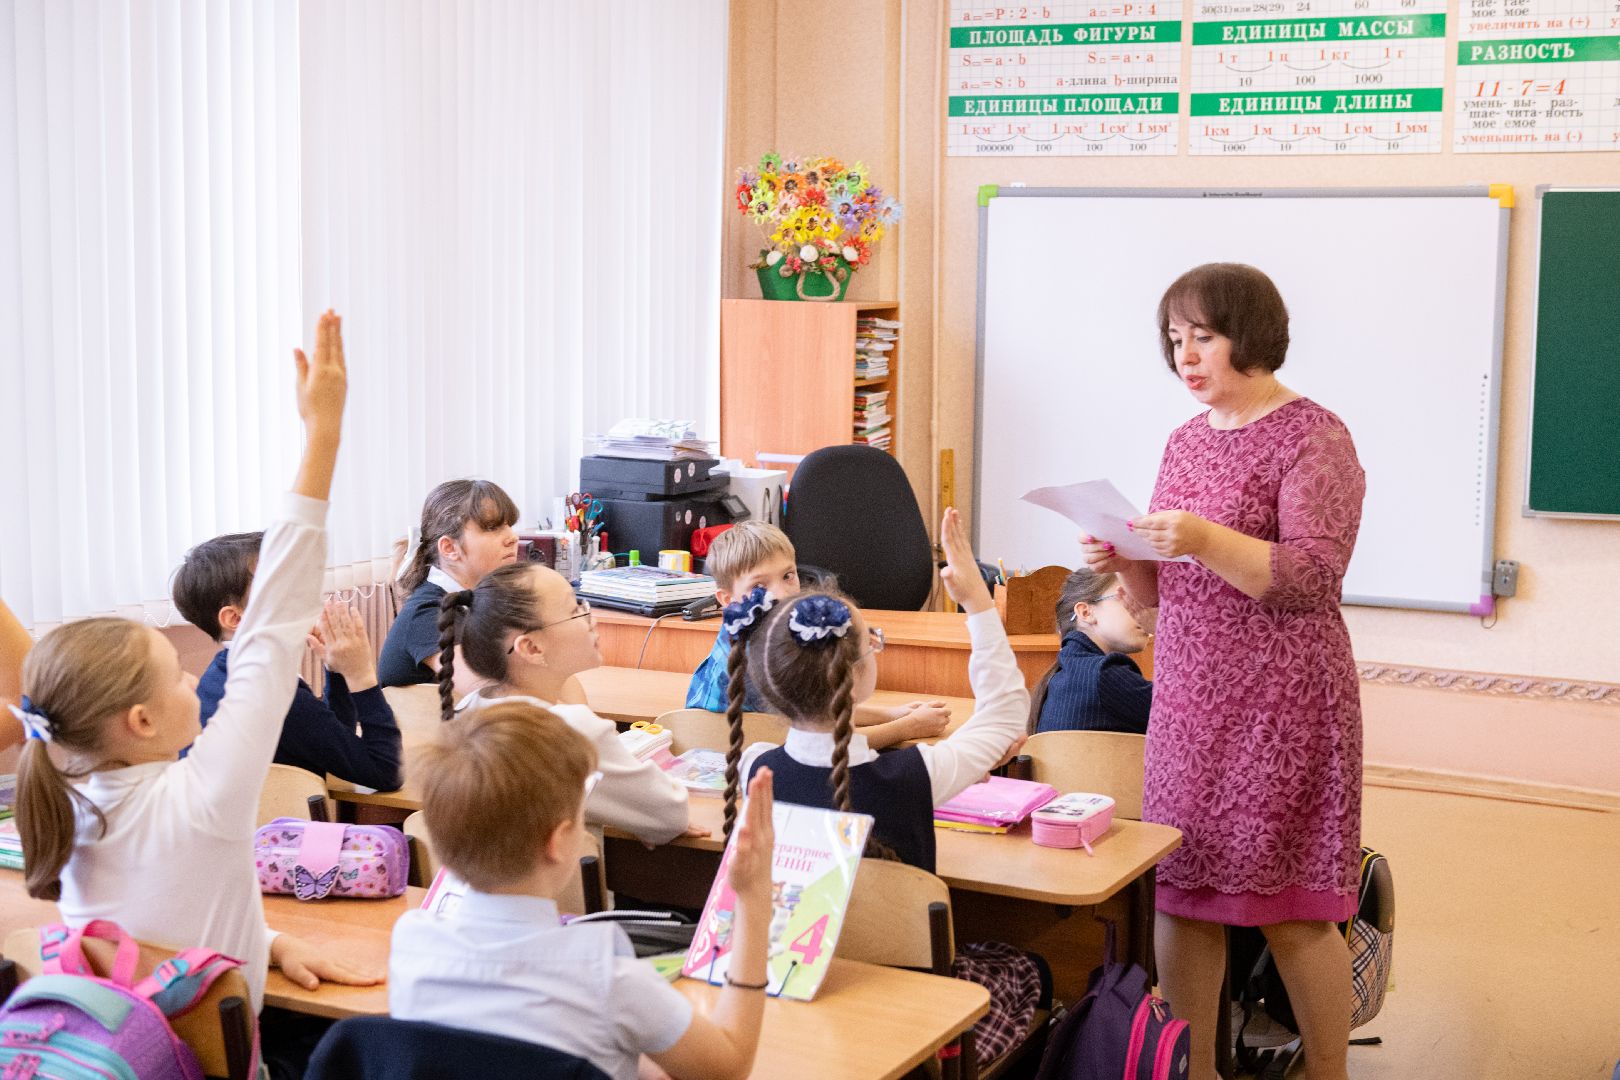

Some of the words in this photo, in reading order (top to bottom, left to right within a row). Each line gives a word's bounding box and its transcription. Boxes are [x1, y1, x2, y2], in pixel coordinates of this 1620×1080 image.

[1296, 2, 1310, 12] 24
[1354, 0, 1369, 9] 60
[1222, 24, 1325, 43] ЕДИНИЦЫ
[1338, 19, 1414, 37] МАССЫ
[1469, 19, 1540, 33] увеличить
[1547, 18, 1563, 28] на
[969, 28, 1064, 46] ПЛОЩАДЬ
[1073, 25, 1156, 42] ФИГУРЫ
[1470, 42, 1575, 61] РАЗНОСТЬ
[1240, 76, 1253, 86] 10
[1295, 75, 1316, 86] 100
[1355, 73, 1383, 84] 1000
[964, 98, 1057, 116] ЕДИНИЦЫ
[1064, 97, 1163, 115] ПЛОЩАДИ
[1219, 96, 1322, 114] ЕДИНИЦЫ
[1334, 94, 1414, 112] ДЛИНЫ
[1545, 109, 1583, 119] ность
[1472, 120, 1497, 129] мое
[1461, 133, 1538, 145] уменьшить
[1545, 132, 1560, 142] на
[1036, 143, 1052, 152] 100
[1087, 143, 1103, 152] 100
[1130, 142, 1147, 152] 100
[1222, 143, 1246, 152] 1000
[1279, 142, 1292, 152] 10
[1335, 142, 1347, 151] 10
[1387, 141, 1399, 151] 10
[789, 914, 830, 965] 4
